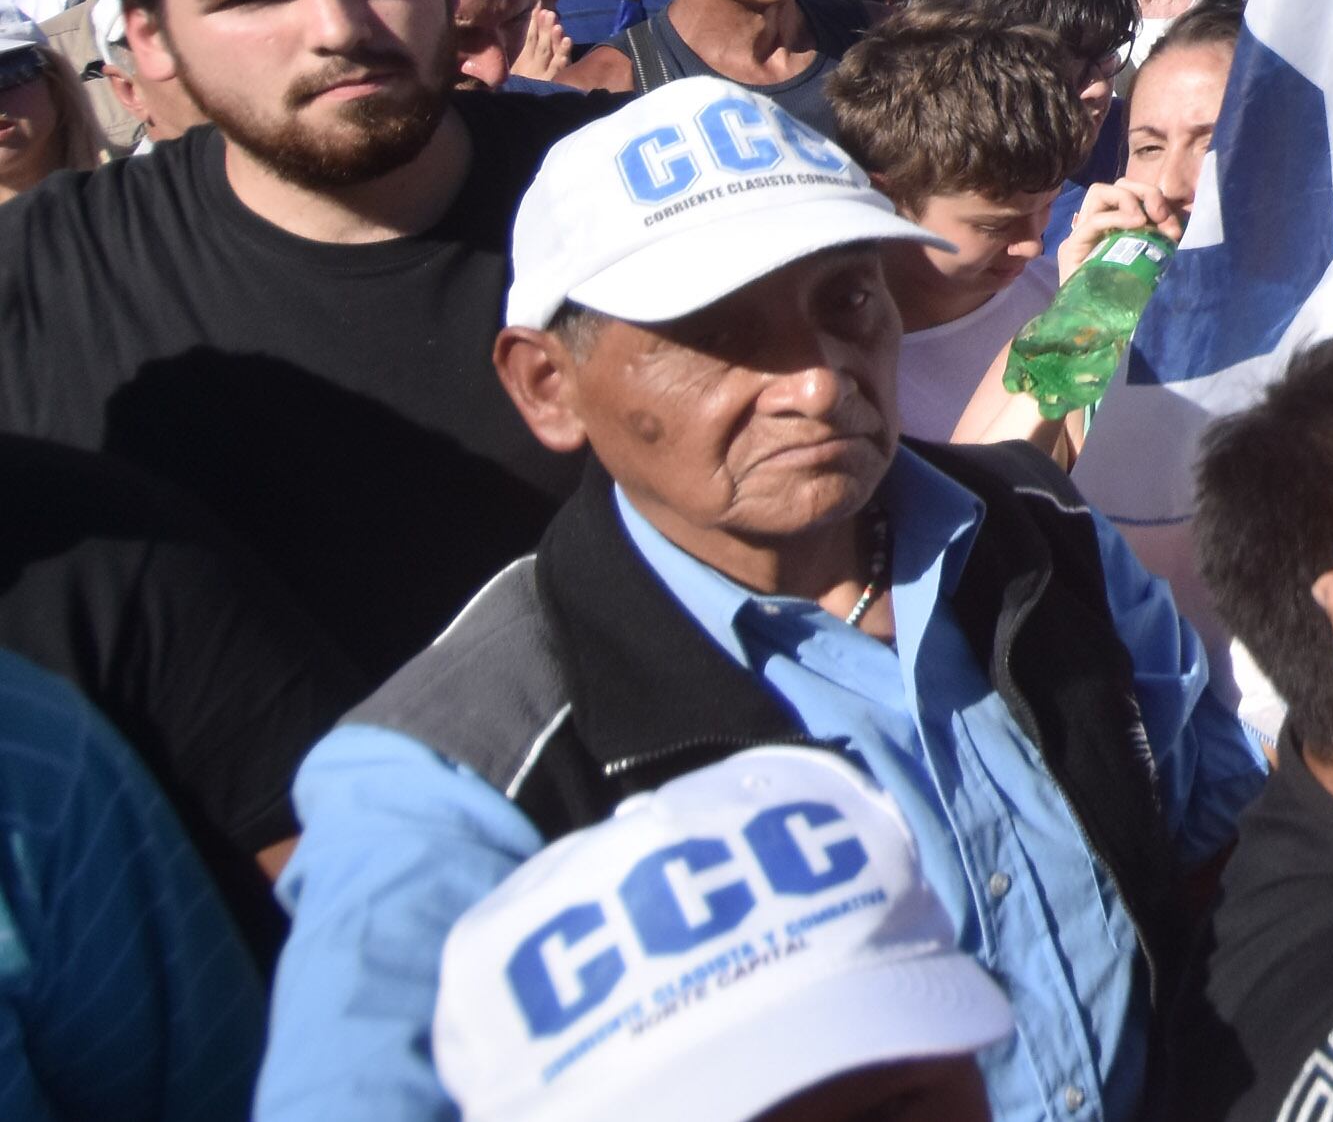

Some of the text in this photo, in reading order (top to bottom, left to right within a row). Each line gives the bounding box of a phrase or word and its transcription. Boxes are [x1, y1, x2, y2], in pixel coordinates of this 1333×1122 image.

[616, 97, 850, 206] CCC
[643, 187, 726, 228] CORRIENTE
[726, 174, 796, 195] CLASISTA
[504, 801, 870, 1042] CCC
[630, 936, 811, 1038] NORTE CAPITAL
